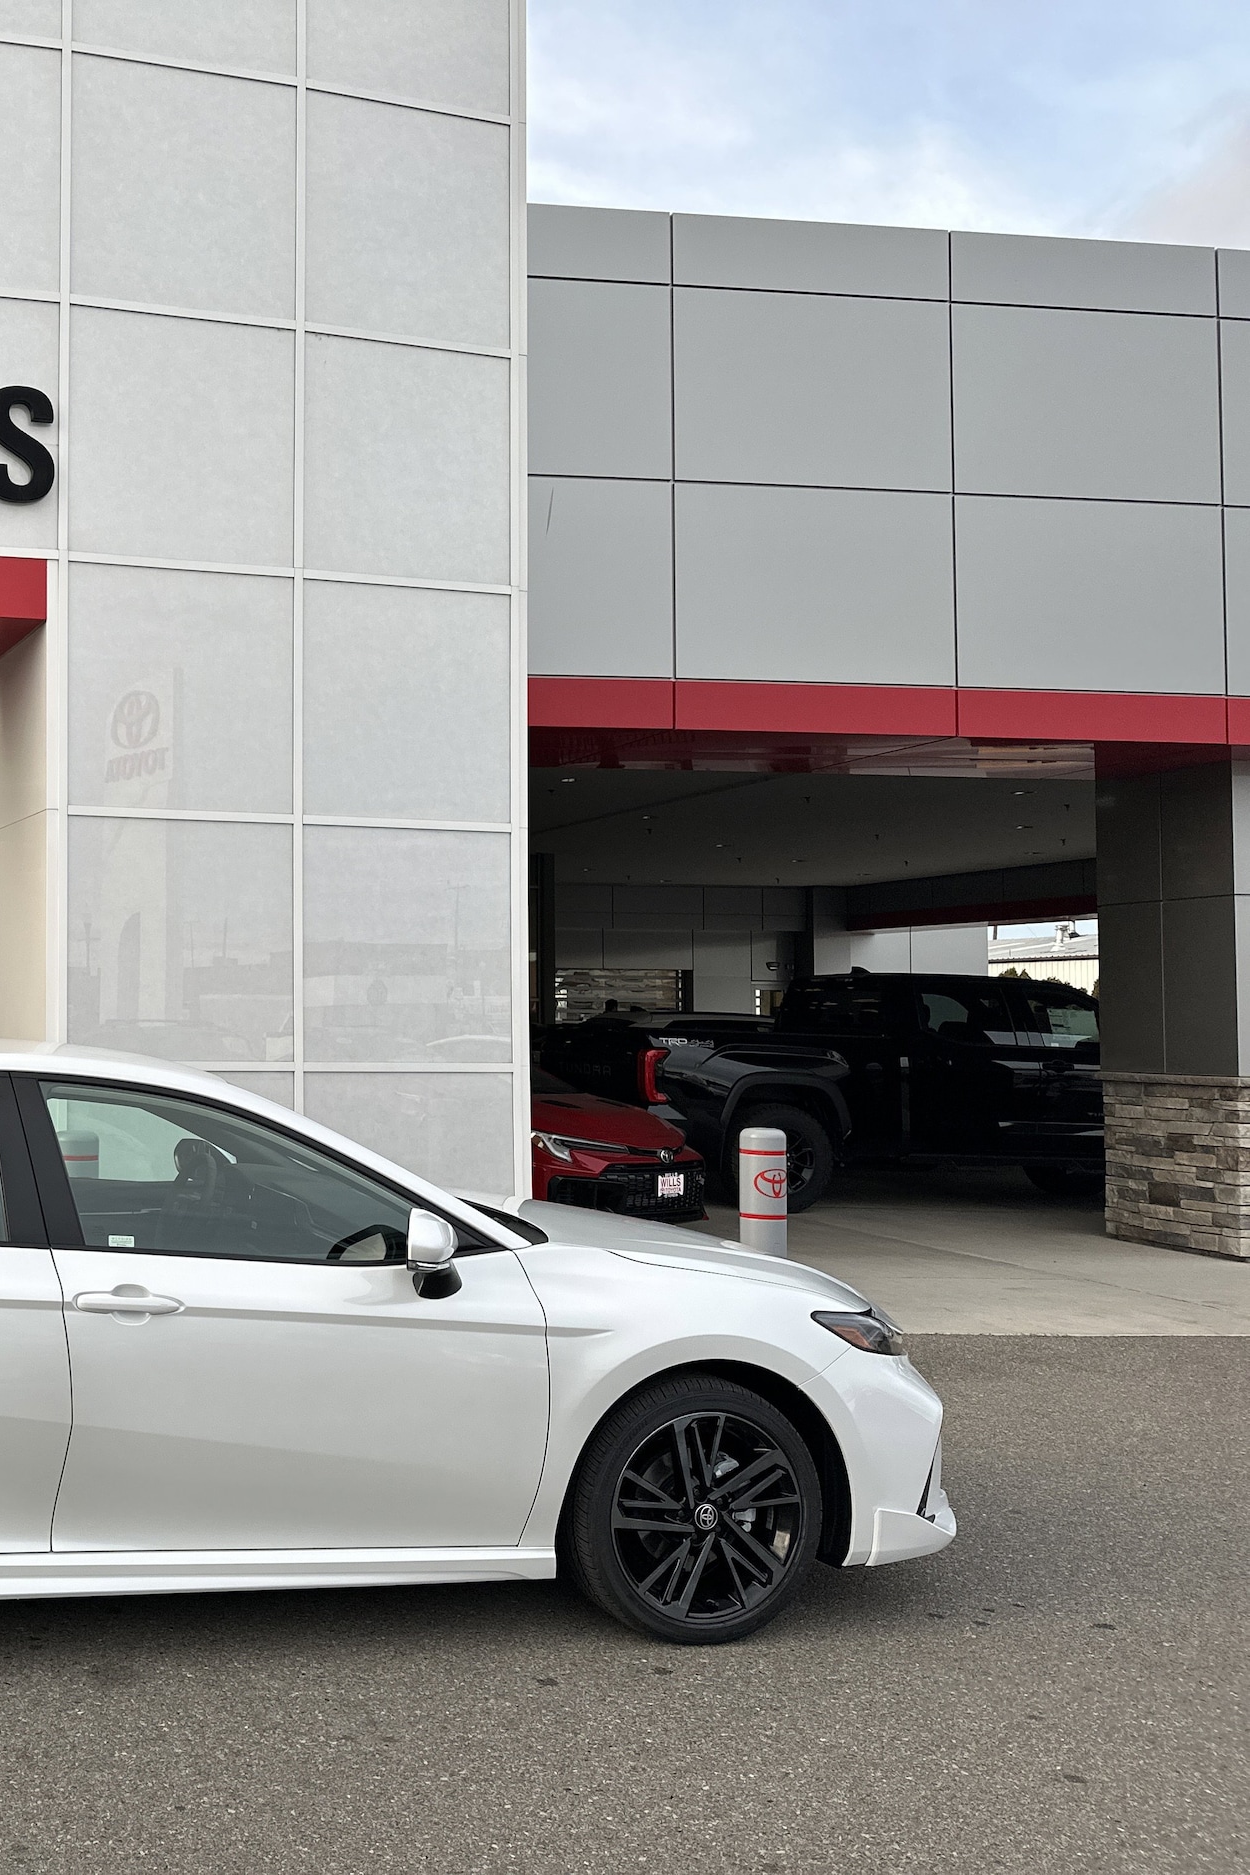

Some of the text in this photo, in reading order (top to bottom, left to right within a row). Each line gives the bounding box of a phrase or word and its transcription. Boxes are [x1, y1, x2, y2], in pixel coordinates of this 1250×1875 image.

[659, 1037, 688, 1047] TRD
[558, 1062, 611, 1077] TUNDRA
[660, 1178, 681, 1187] WILLS
